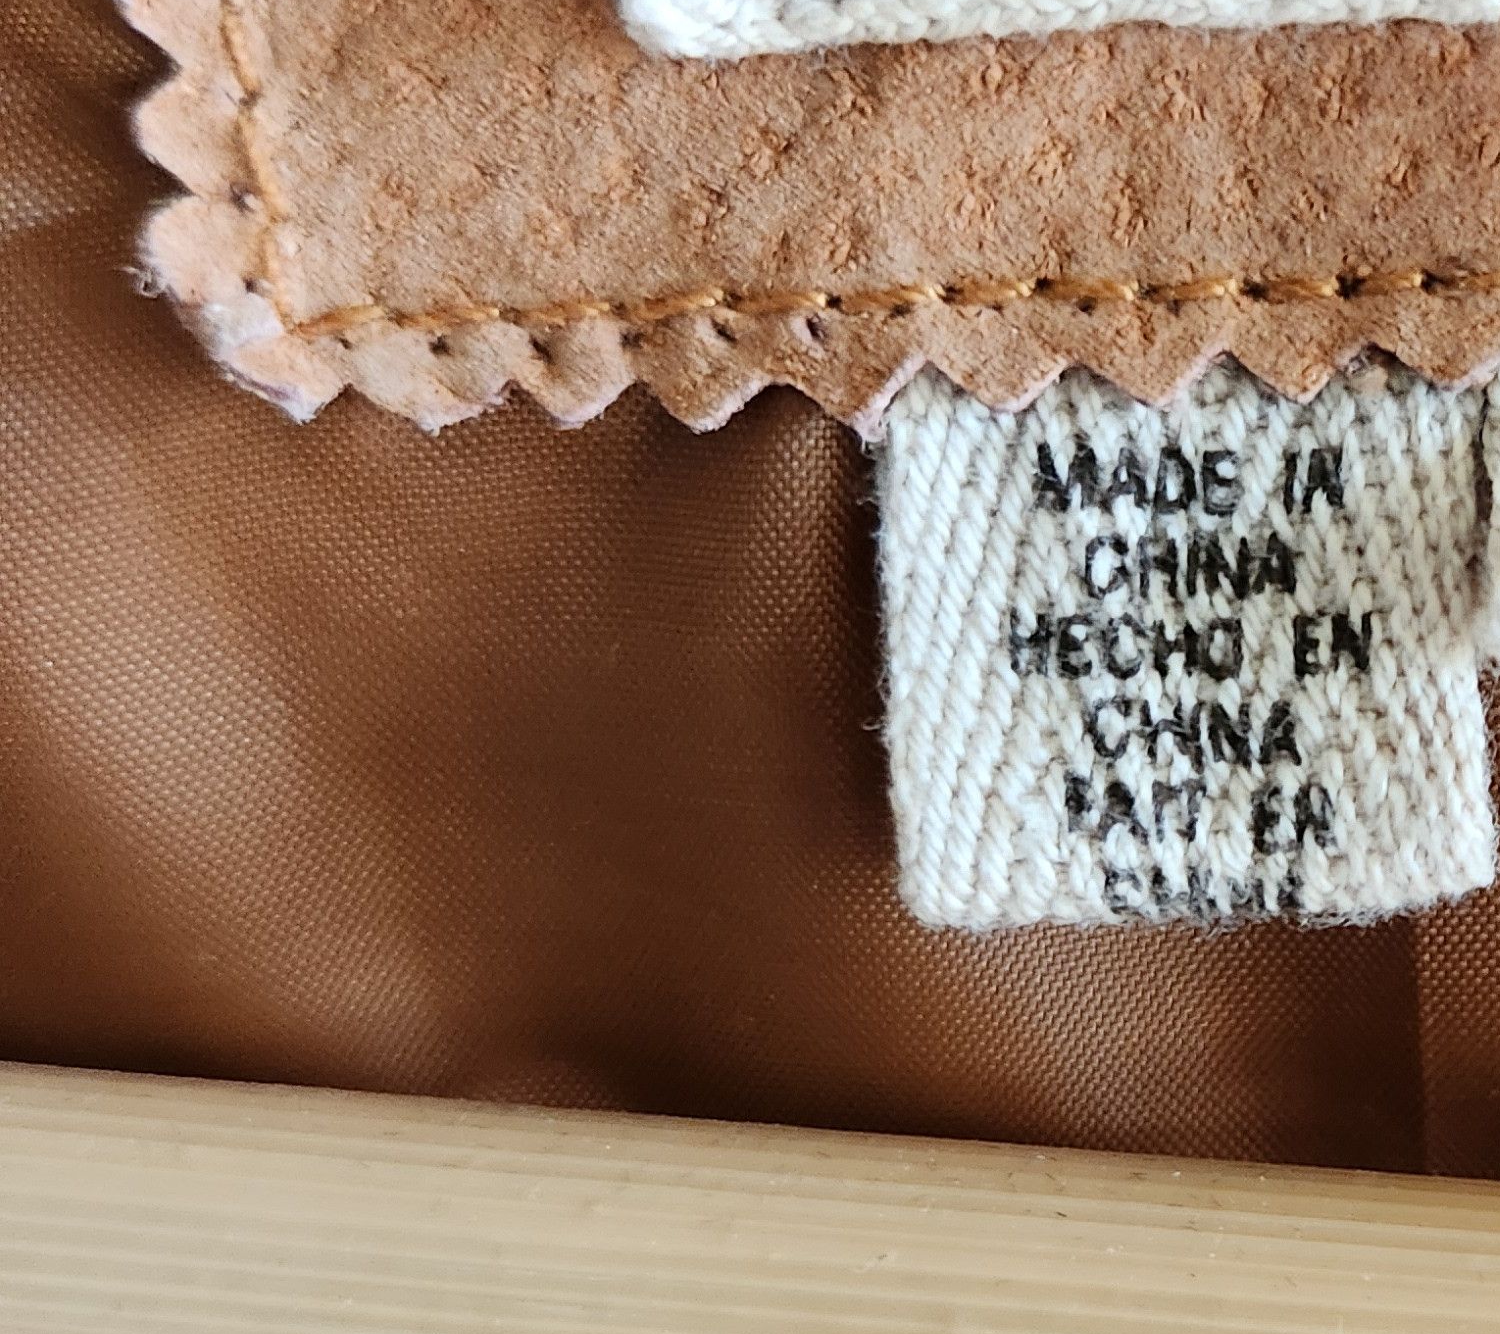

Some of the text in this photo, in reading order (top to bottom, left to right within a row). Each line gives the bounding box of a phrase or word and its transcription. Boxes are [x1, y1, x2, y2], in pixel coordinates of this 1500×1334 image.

[1034, 442, 1345, 517] MADE IN
[1085, 533, 1298, 599] CHINA
[1009, 609, 1373, 680] HECHO EN
[1090, 695, 1302, 767] CHINA
